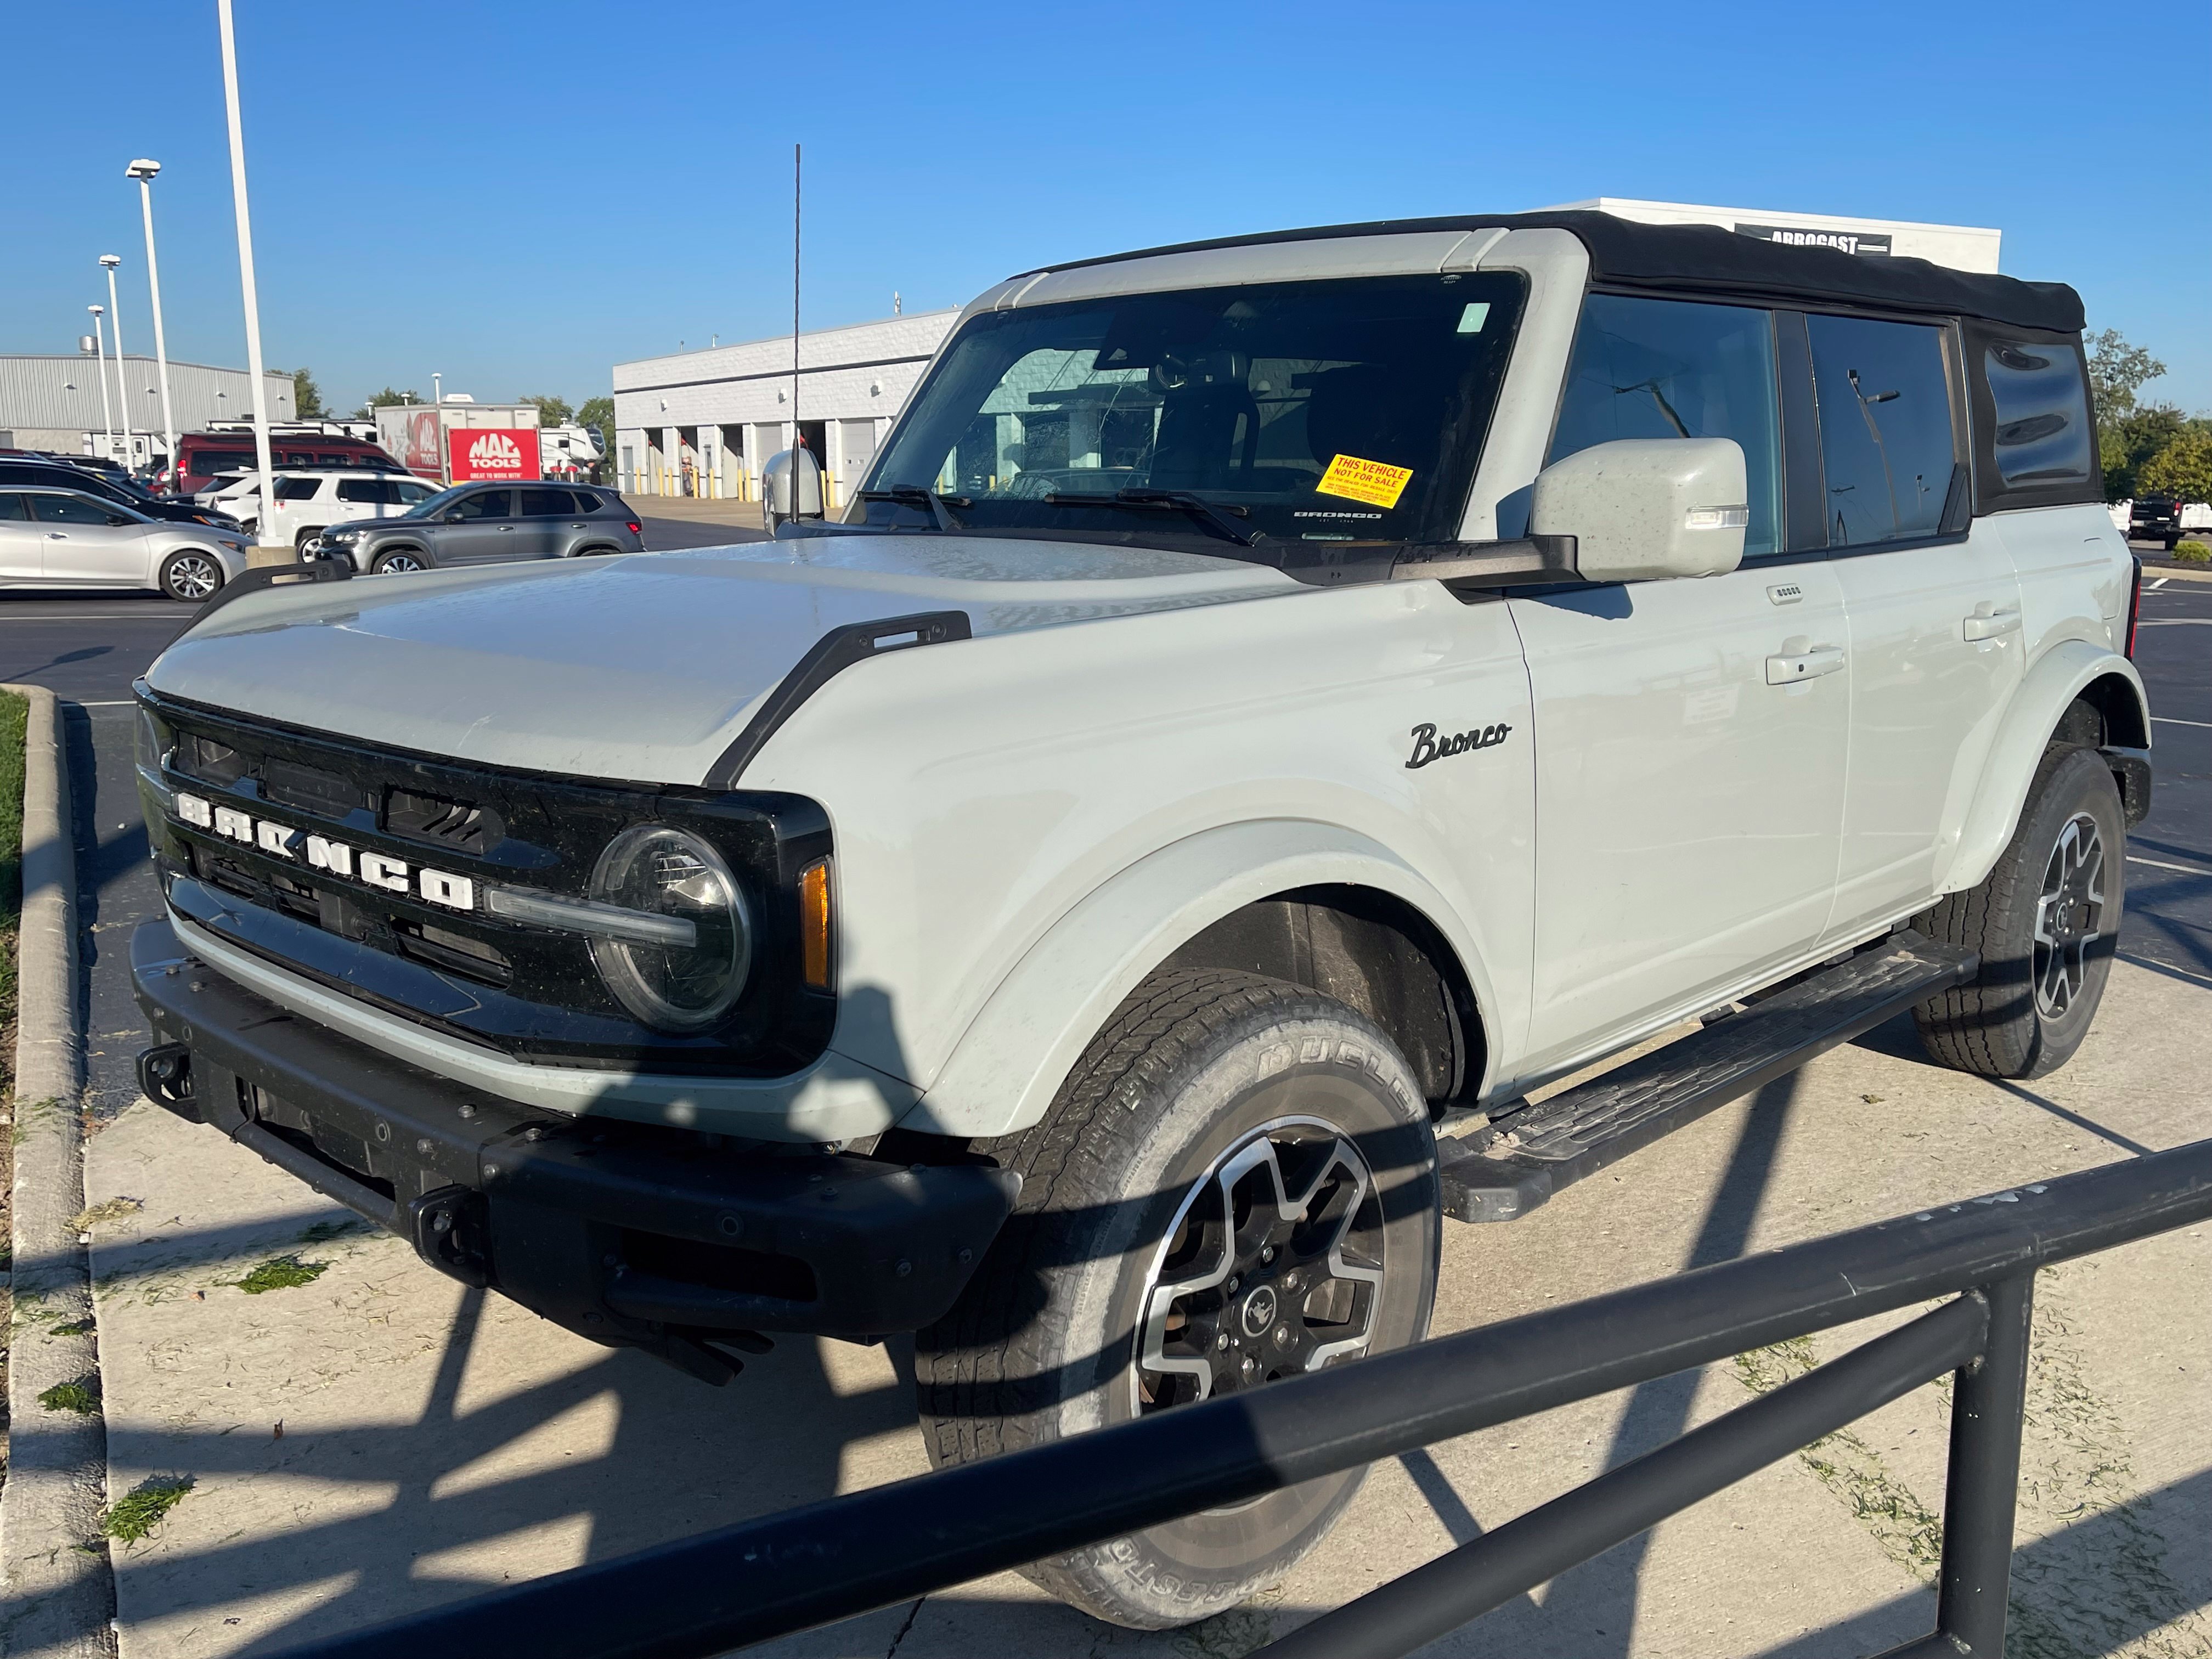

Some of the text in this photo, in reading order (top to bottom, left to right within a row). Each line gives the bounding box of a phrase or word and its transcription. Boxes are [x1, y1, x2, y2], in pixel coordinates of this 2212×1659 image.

[1772, 231, 1858, 255] ARROGAST
[469, 433, 521, 458] MAC
[420, 453, 438, 466] TOOLS
[469, 459, 521, 468] TOOLS
[1337, 457, 1407, 480] THIS VEHICLE
[1334, 468, 1399, 487] NOT FOR SALE
[1405, 723, 1513, 769] Bronco
[178, 792, 473, 910] BRONCO
